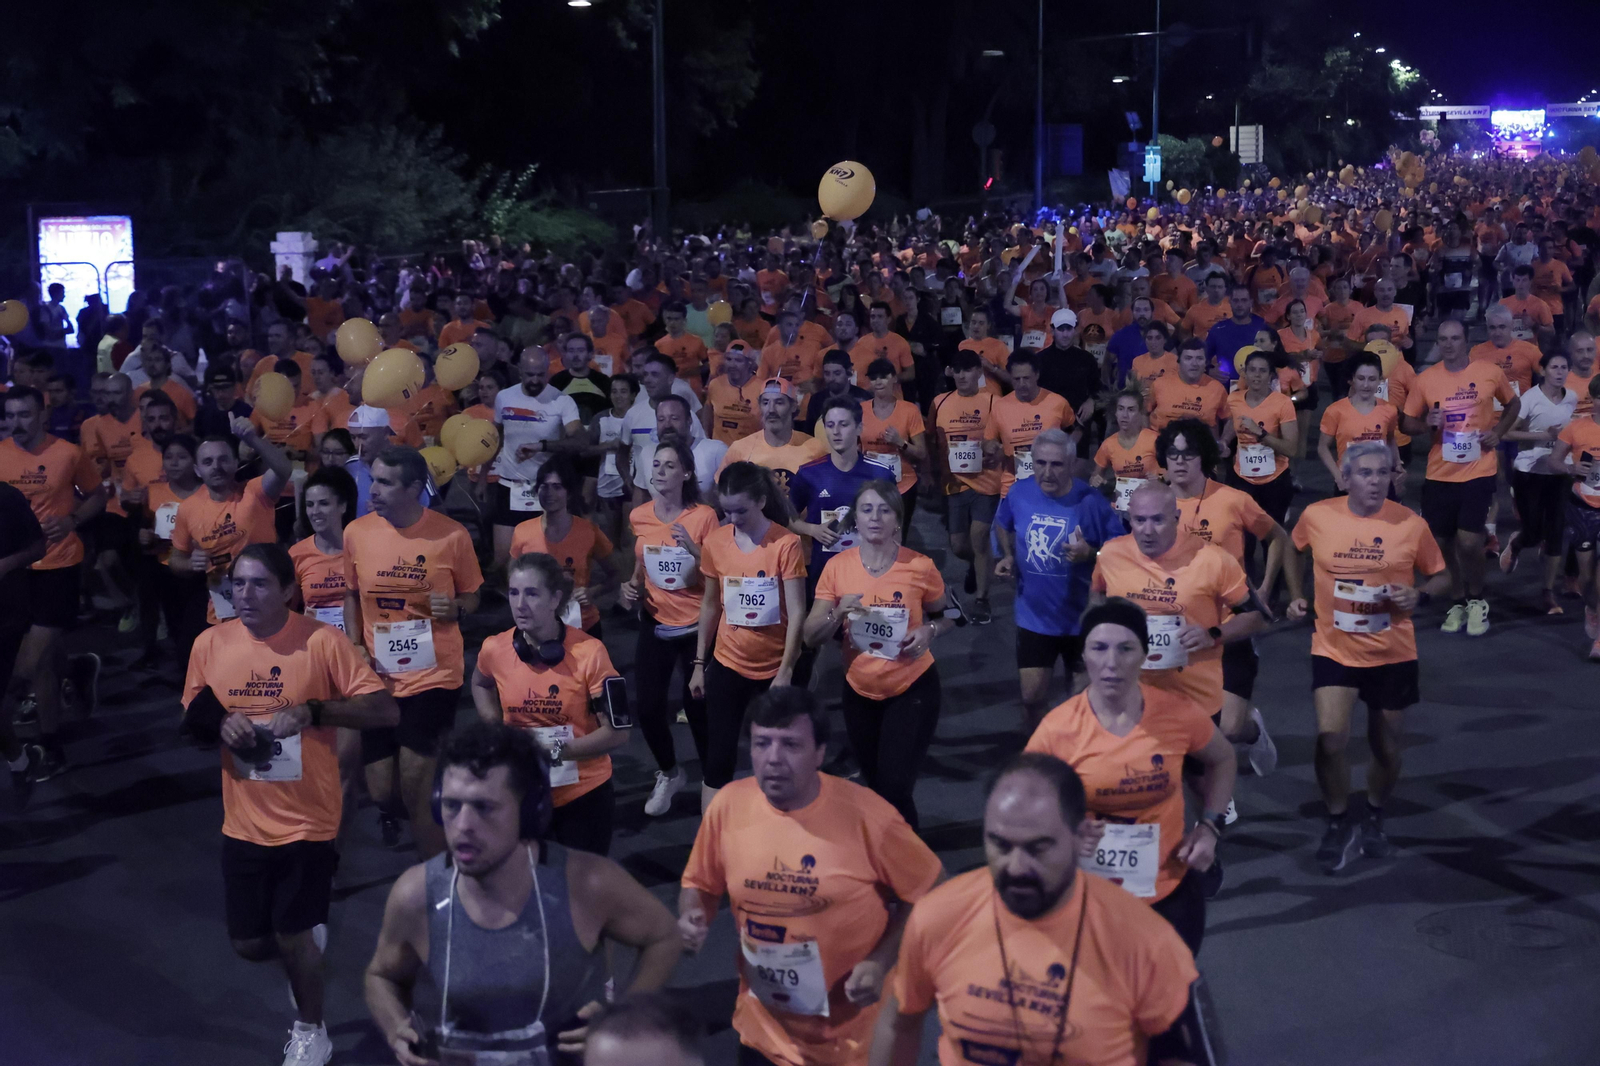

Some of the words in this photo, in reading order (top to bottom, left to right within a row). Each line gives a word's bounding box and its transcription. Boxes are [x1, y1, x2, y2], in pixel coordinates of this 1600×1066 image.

[1452, 442, 1472, 450] 3683
[954, 451, 976, 460] 18263
[1245, 455, 1267, 464] 14791
[1349, 547, 1385, 555] NOCTURNA
[392, 565, 428, 573] NOCTURNA
[658, 561, 682, 573] 5837
[376, 570, 407, 579] SEVILLA
[408, 573, 426, 581] KH7
[1142, 587, 1178, 596] NOCTURNA
[738, 593, 766, 606] 7962
[1126, 592, 1157, 602] SEVILLA
[864, 622, 893, 638] 7963
[388, 638, 418, 652] 2545
[228, 689, 263, 697] SEVILLA
[263, 688, 283, 698] KH7
[541, 707, 562, 715] KH7
[1095, 848, 1139, 868] 8276
[766, 872, 820, 885] NOCTURNA
[744, 878, 788, 893] SEVILLA
[790, 884, 818, 897] KH7
